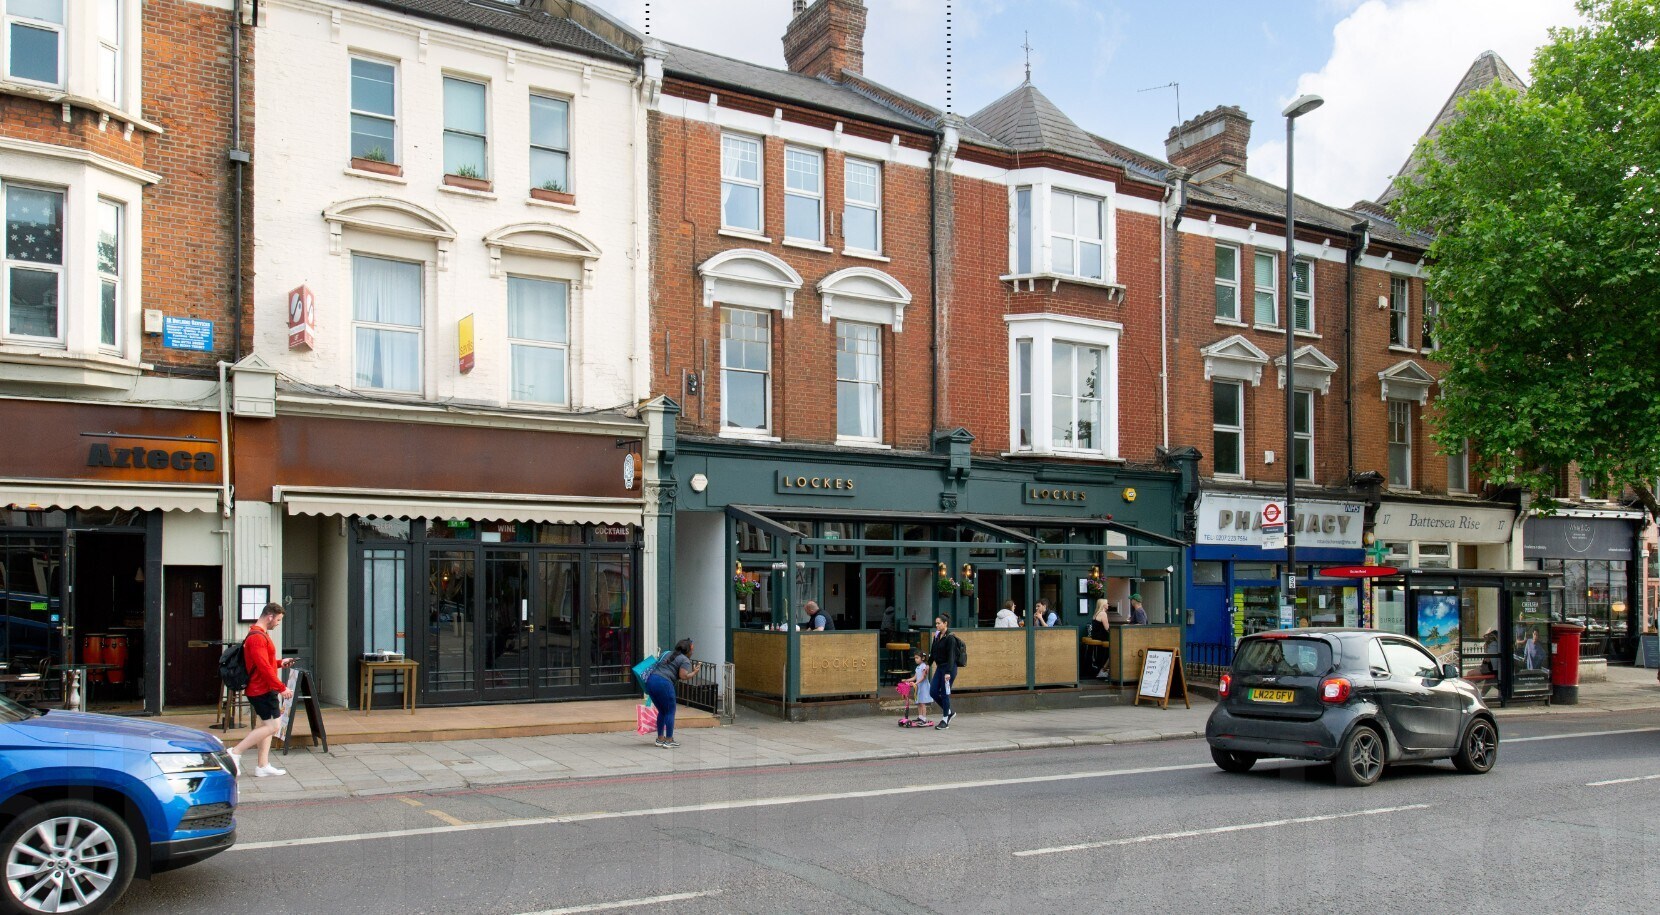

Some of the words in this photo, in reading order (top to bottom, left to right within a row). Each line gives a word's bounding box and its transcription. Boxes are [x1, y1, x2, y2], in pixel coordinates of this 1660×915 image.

[87, 443, 215, 471] Azteca
[784, 475, 854, 491] LOCKES
[1031, 488, 1087, 501] LOCKES
[1383, 514, 1391, 525] 17
[1409, 513, 1456, 528] Battersea
[1459, 515, 1481, 530] Rise
[1498, 520, 1506, 530] 17
[497, 524, 516, 533] WINE
[594, 527, 630, 535] COCKTAILS
[811, 656, 867, 670] LOCKES
[1253, 689, 1273, 700] LM22
[1276, 690, 1292, 700] GFV
